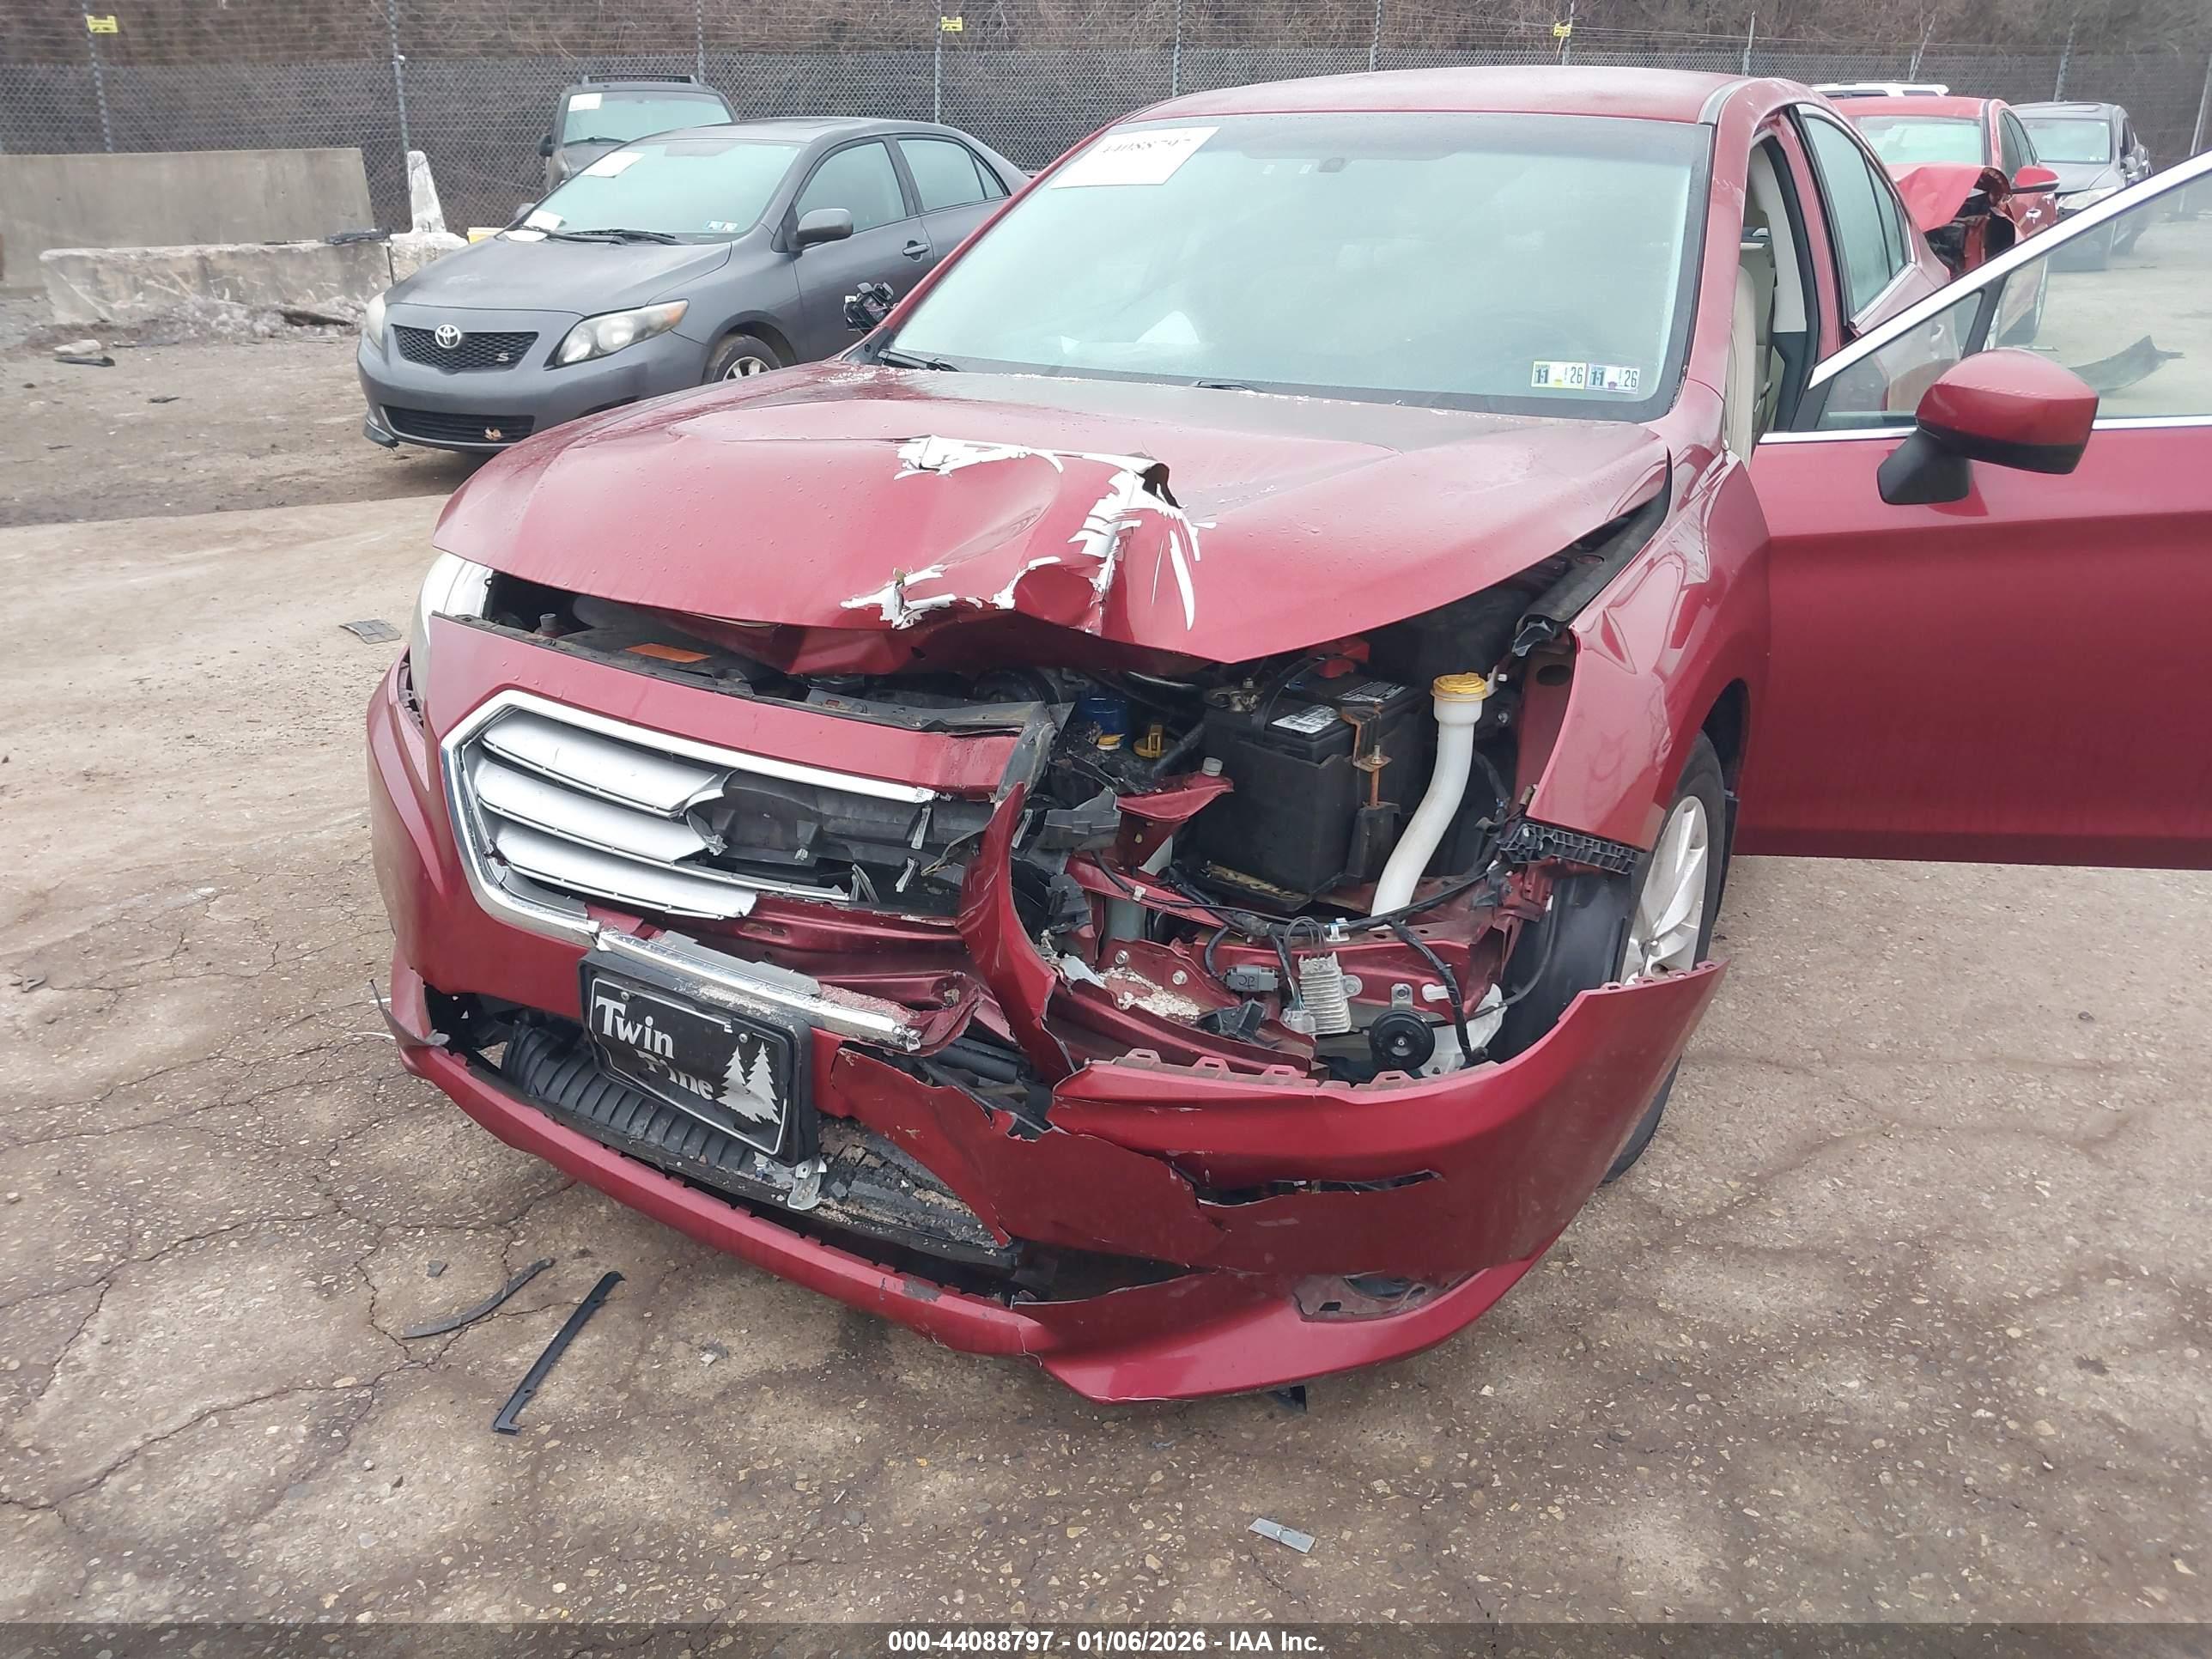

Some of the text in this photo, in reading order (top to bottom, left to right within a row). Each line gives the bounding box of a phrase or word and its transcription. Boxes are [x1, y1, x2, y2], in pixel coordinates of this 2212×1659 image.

[496, 352, 509, 362] S
[1570, 366, 1583, 384] 26
[1624, 369, 1638, 388] 26
[595, 995, 676, 1060] Twin
